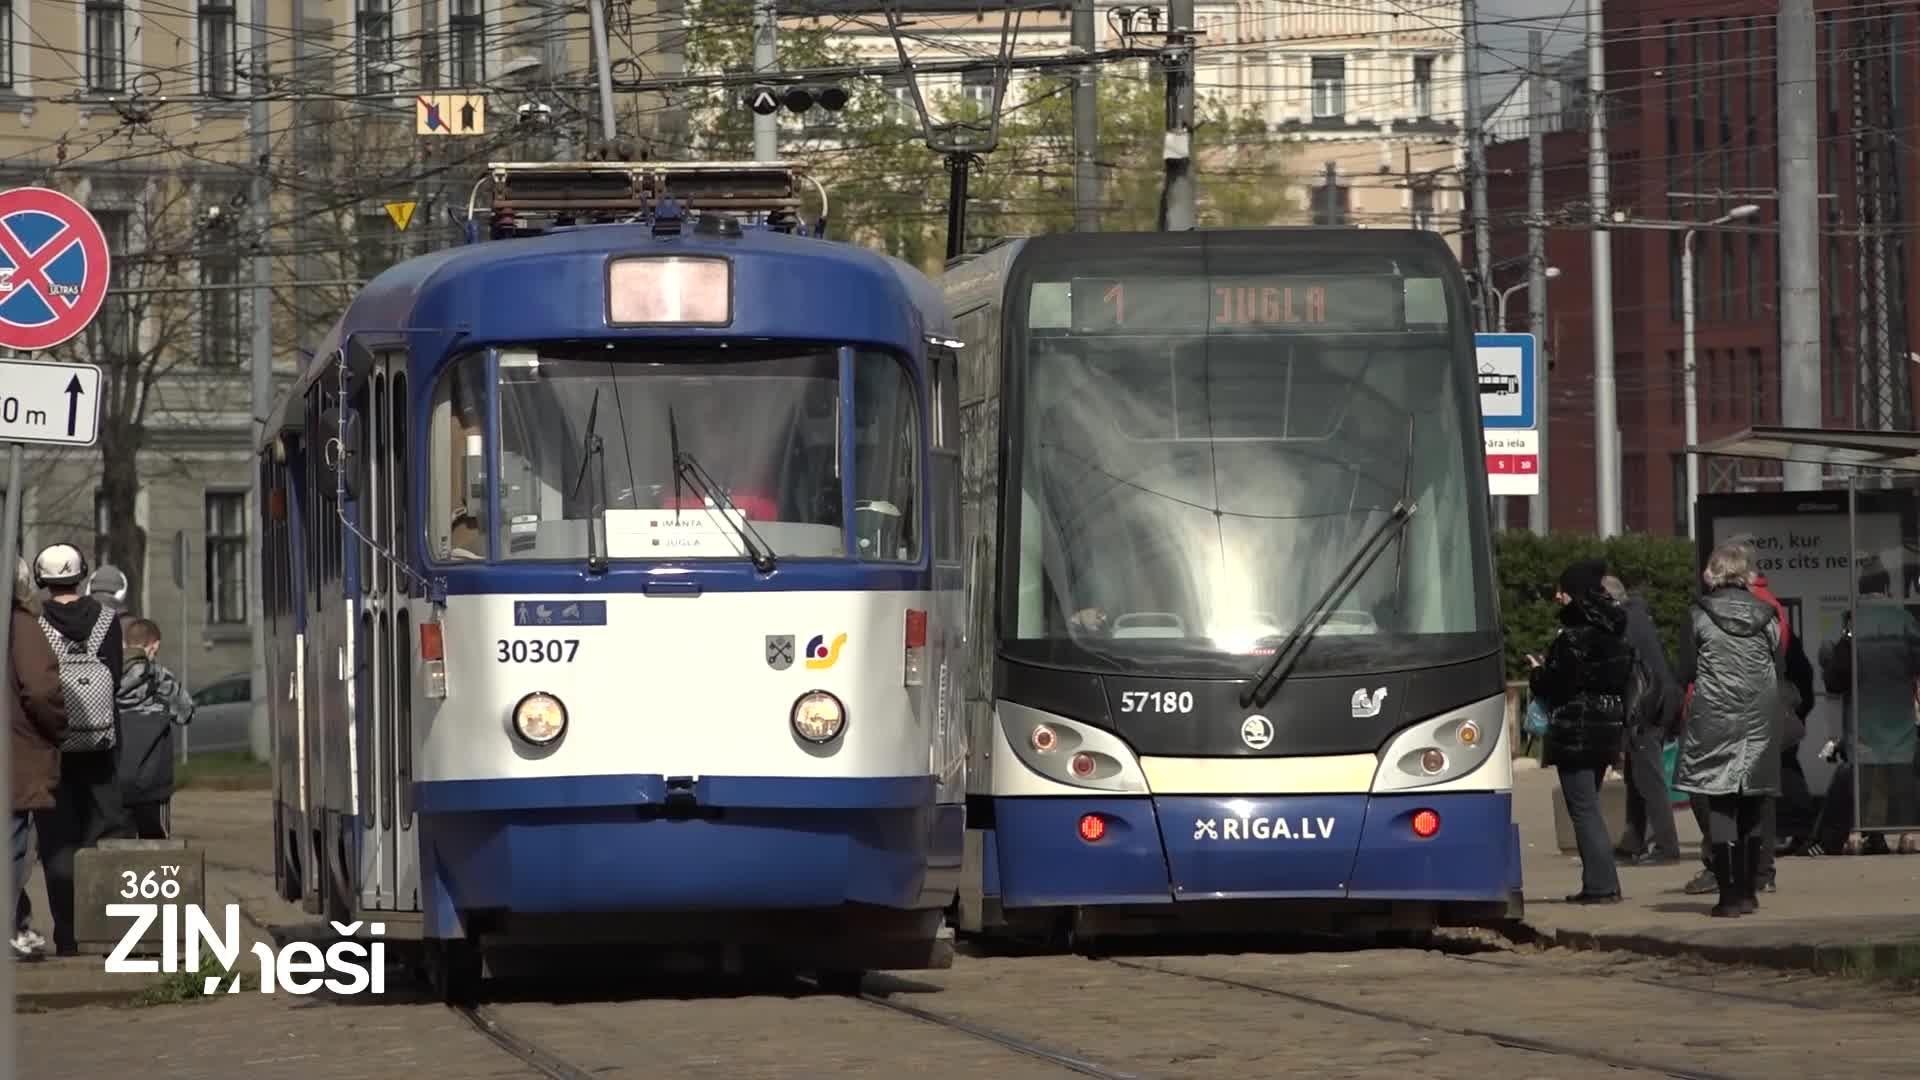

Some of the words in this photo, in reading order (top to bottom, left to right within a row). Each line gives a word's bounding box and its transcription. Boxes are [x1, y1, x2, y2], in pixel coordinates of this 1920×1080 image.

[1215, 287, 1328, 324] JUGLA
[26, 409, 46, 425] m
[497, 639, 580, 663] 30307
[1121, 691, 1194, 713] 57180
